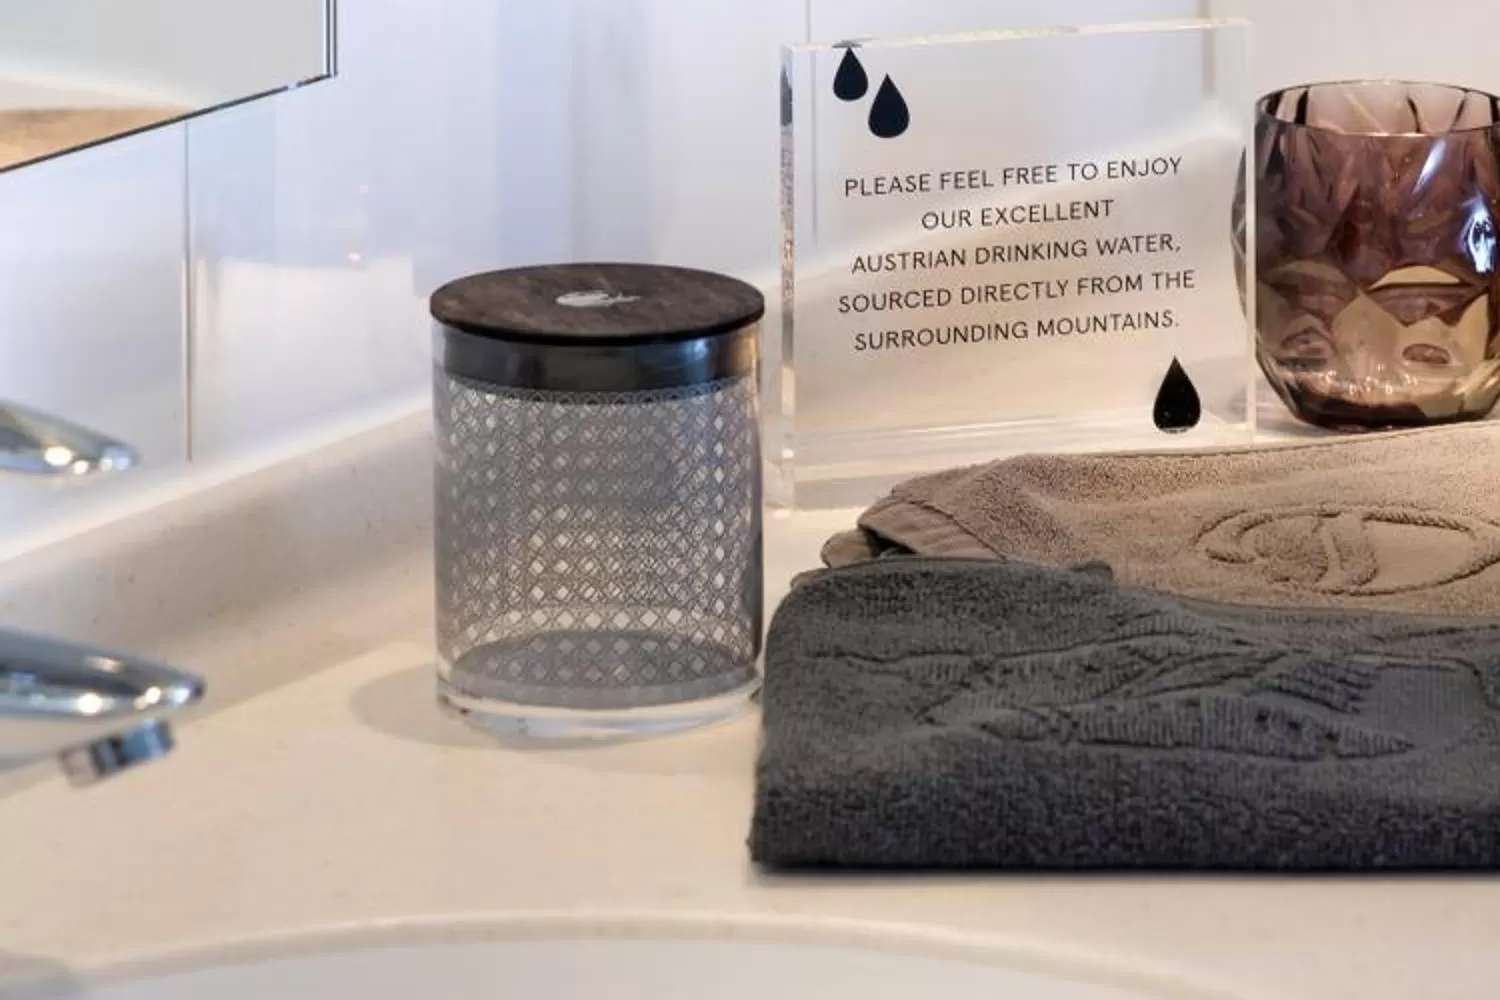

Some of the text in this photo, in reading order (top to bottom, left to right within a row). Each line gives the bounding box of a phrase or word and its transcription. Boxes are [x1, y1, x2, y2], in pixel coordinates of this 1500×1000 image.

[844, 155, 1183, 198] PLEASE FEEL FREE TO ENJOY
[921, 199, 1115, 231] OUR EXCELLENT
[850, 233, 1182, 275] AUSTRIAN DRINKING WATER,
[838, 269, 1196, 314] SOURCED DIRECTLY FROM THE
[854, 310, 1180, 352] SURROUNDING MOUNTAINS.
